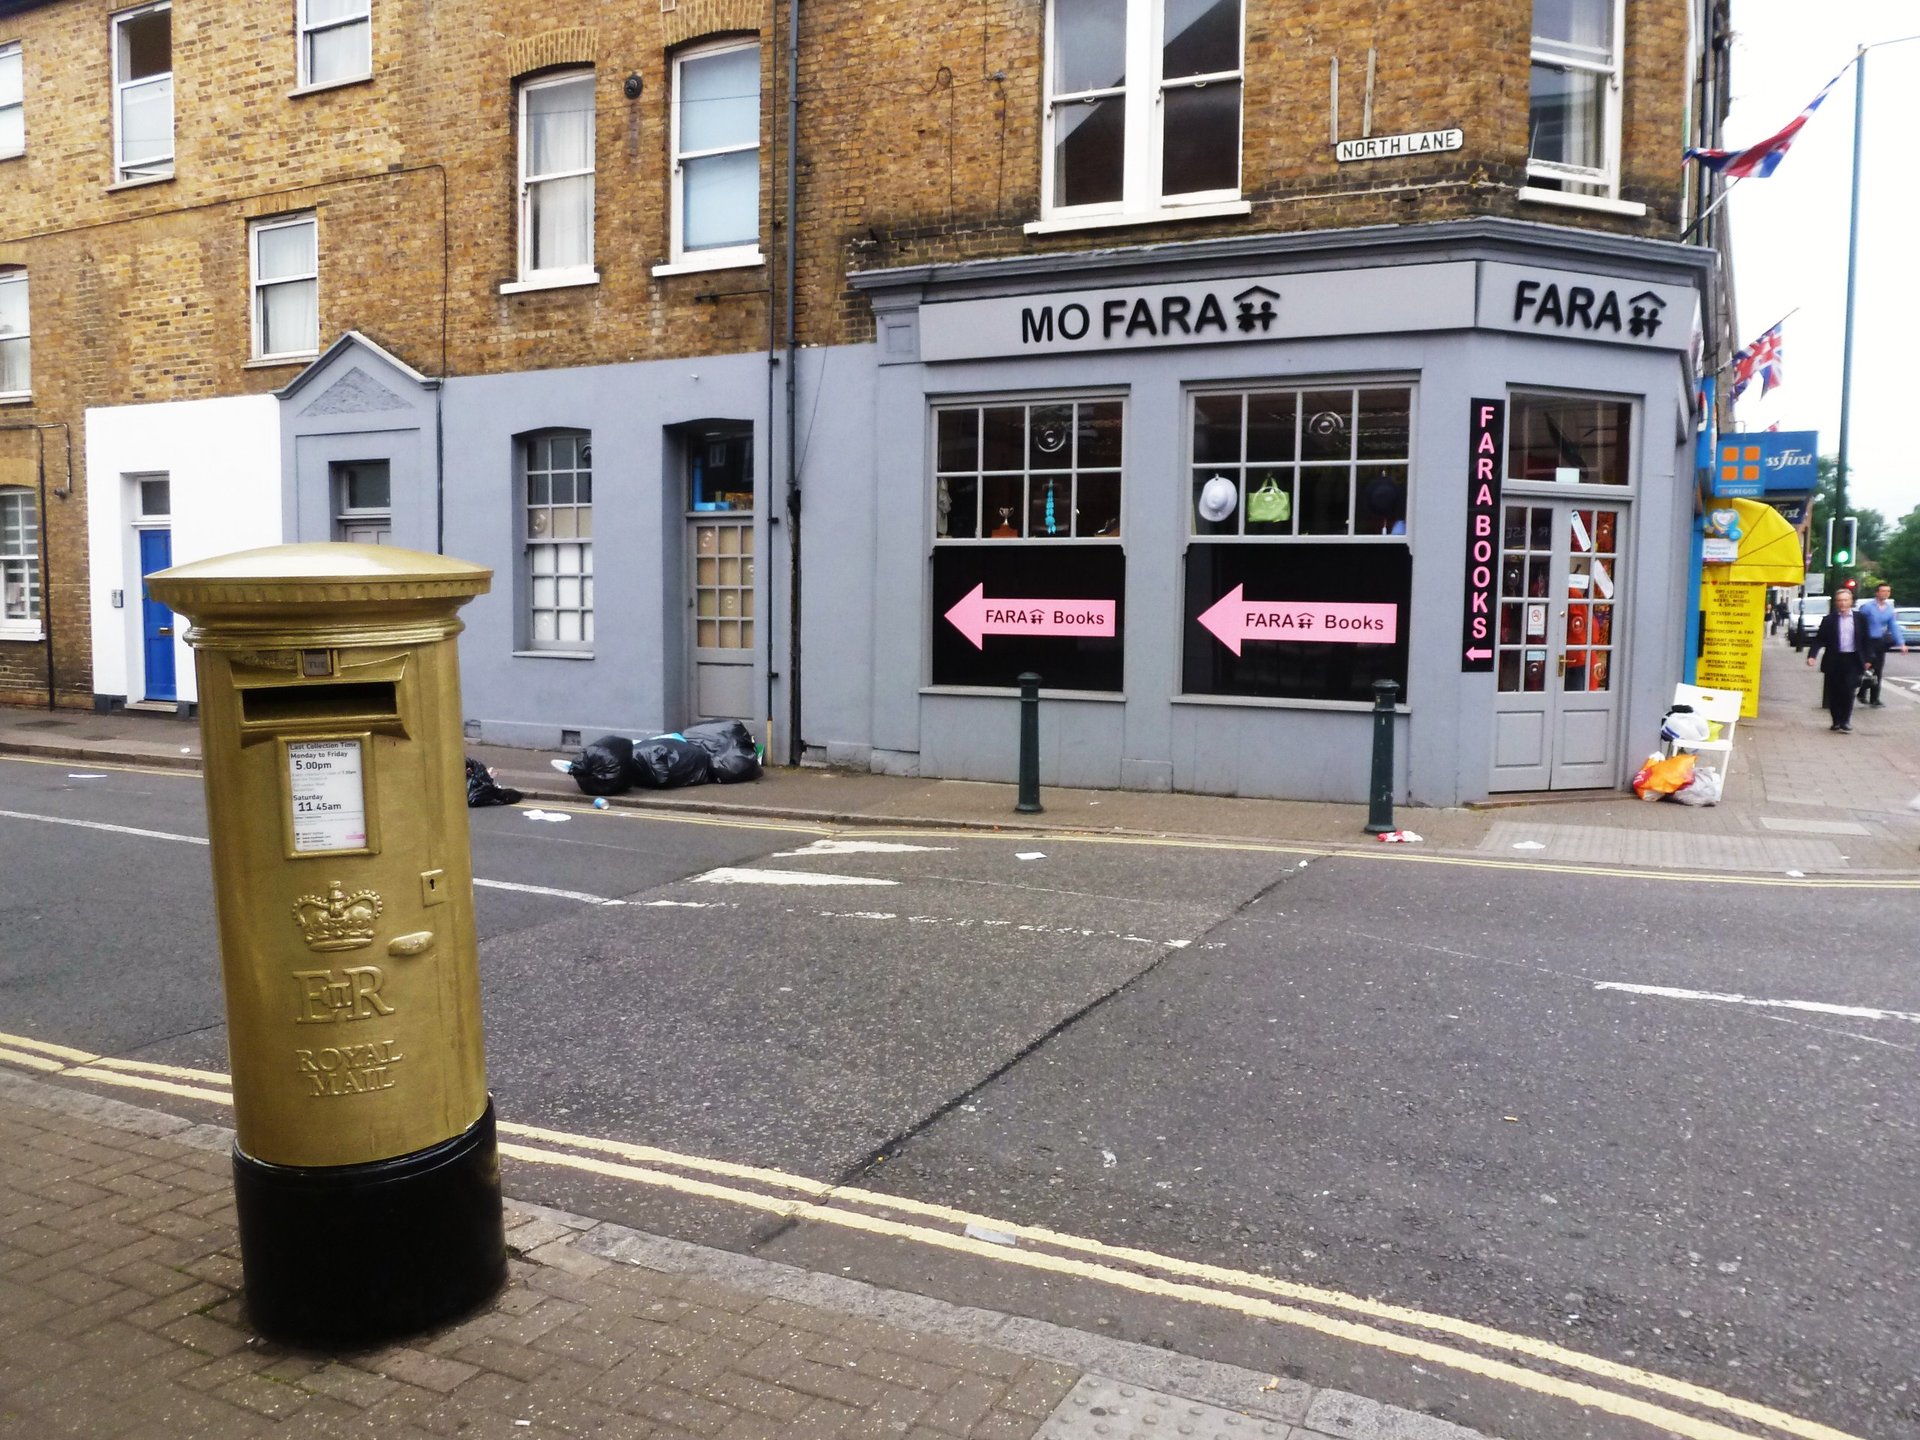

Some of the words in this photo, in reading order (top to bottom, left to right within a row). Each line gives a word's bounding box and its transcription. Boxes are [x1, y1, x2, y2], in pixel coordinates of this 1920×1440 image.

[1343, 136, 1400, 159] NORTH
[1408, 131, 1456, 153] LANE
[1021, 302, 1090, 344] MO
[1103, 293, 1228, 338] FARA
[1514, 279, 1623, 332] FARA
[1475, 405, 1495, 506] FARA
[1728, 487, 1758, 495] GREGGS
[1472, 514, 1492, 640] BOOKS
[985, 609, 1028, 624] FARA
[1053, 610, 1105, 625] Books
[1245, 612, 1294, 628] FARA
[1324, 614, 1384, 630] Books
[290, 743, 305, 751] Last
[306, 742, 339, 750] Collection
[295, 759, 332, 771] 5.00pm
[296, 1039, 405, 1072] ROYAL
[308, 1066, 396, 1097] MAIL
